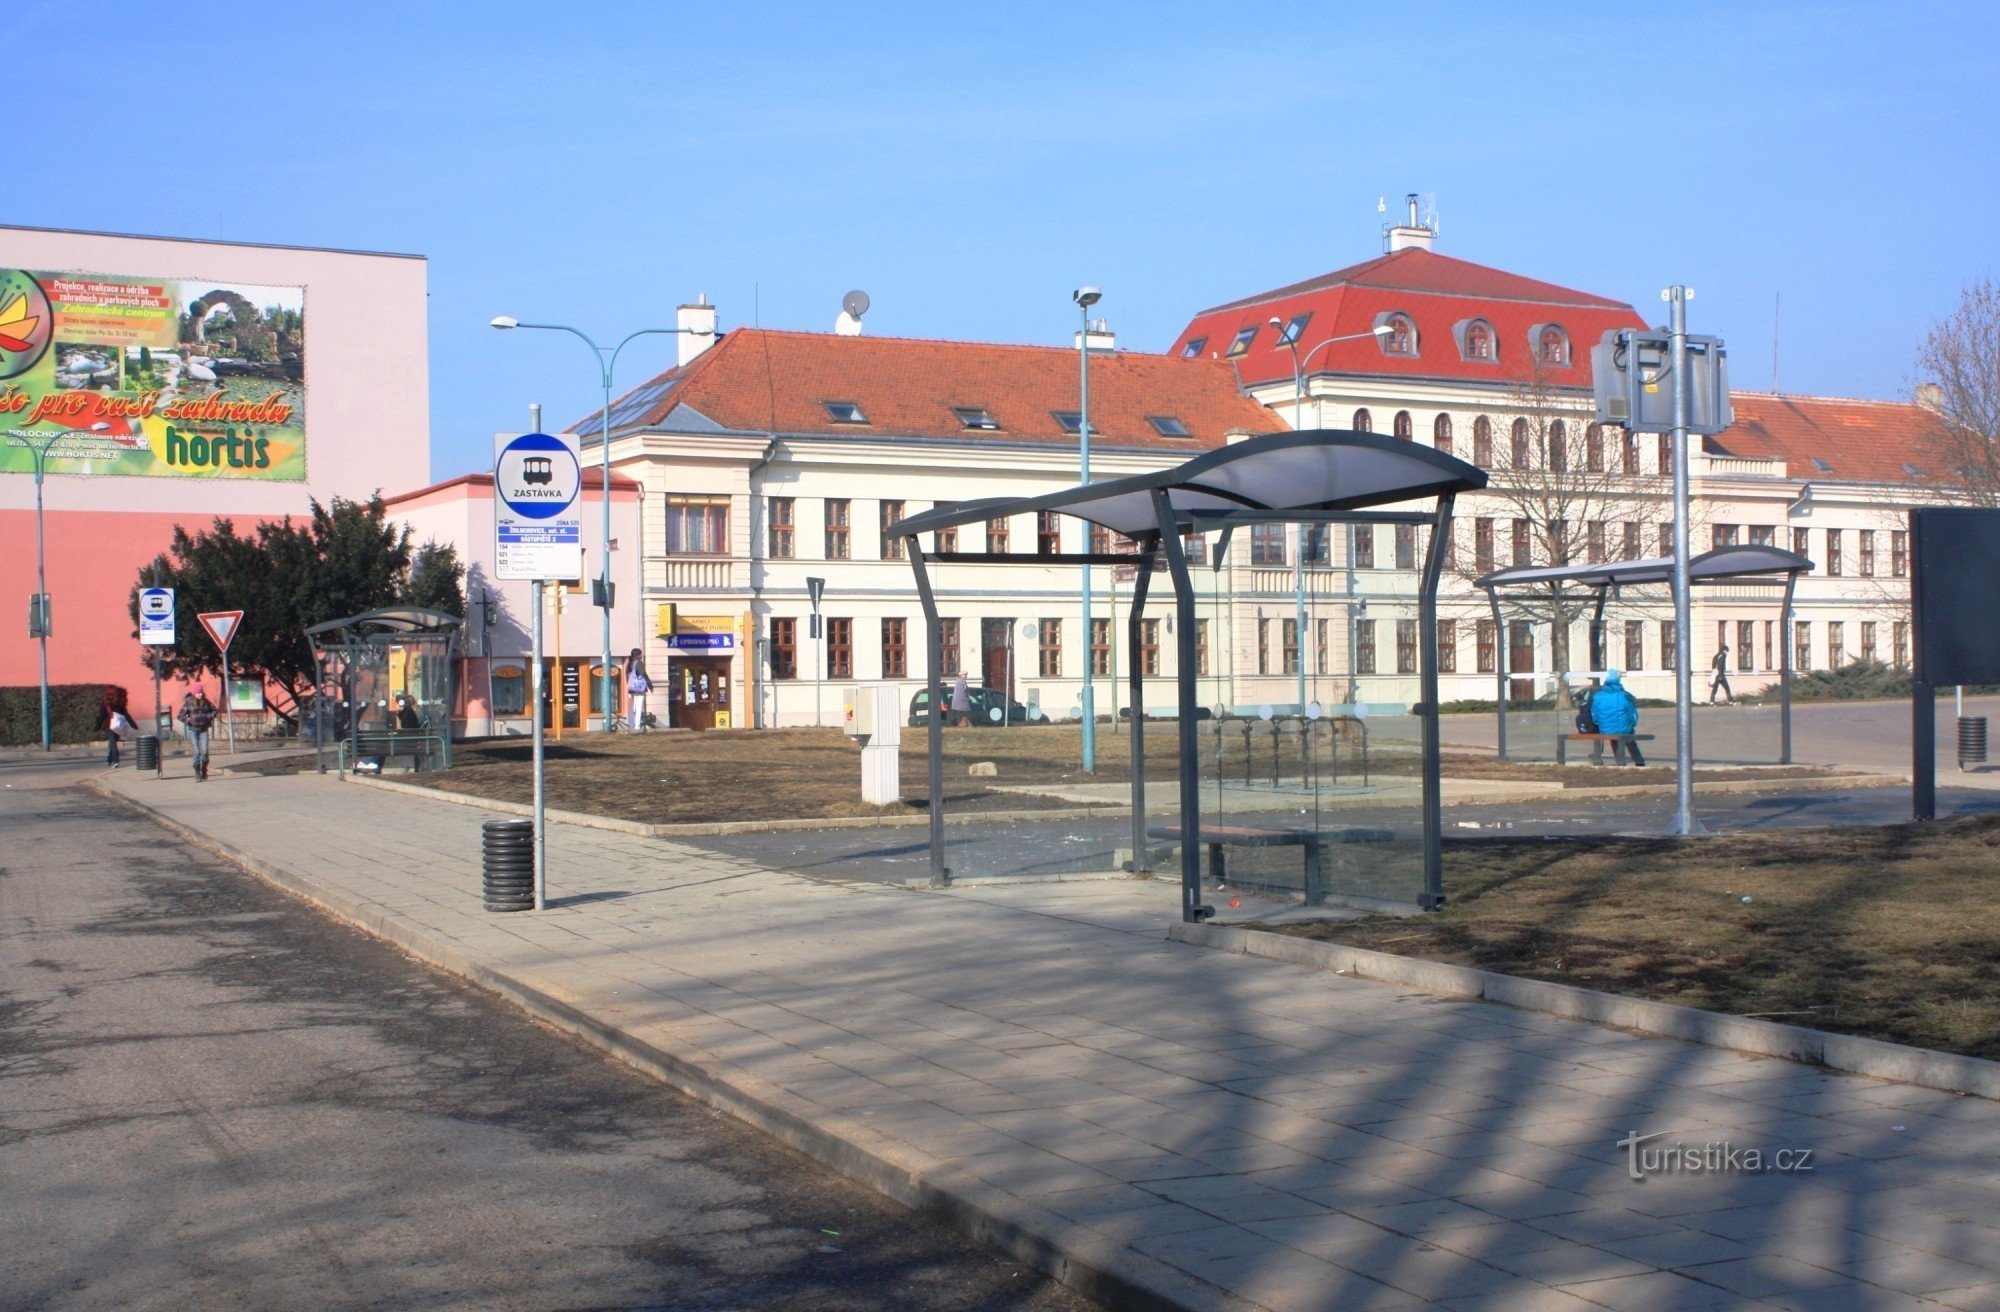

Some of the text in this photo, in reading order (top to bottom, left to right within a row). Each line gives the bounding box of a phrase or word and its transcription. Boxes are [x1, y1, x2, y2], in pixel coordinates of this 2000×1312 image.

[54, 280, 86, 292] Projekce,
[88, 282, 119, 293] realizace
[126, 284, 149, 295] údržba
[59, 293, 97, 303] zahradních
[104, 295, 140, 306] parkových
[141, 298, 160, 307] ploch
[125, 308, 166, 318] centrum
[19, 393, 88, 426] pro
[92, 389, 159, 418] vaši
[162, 388, 293, 424] zahradu
[166, 425, 270, 468] hortis
[513, 488, 562, 498] ZASTÁVKA
